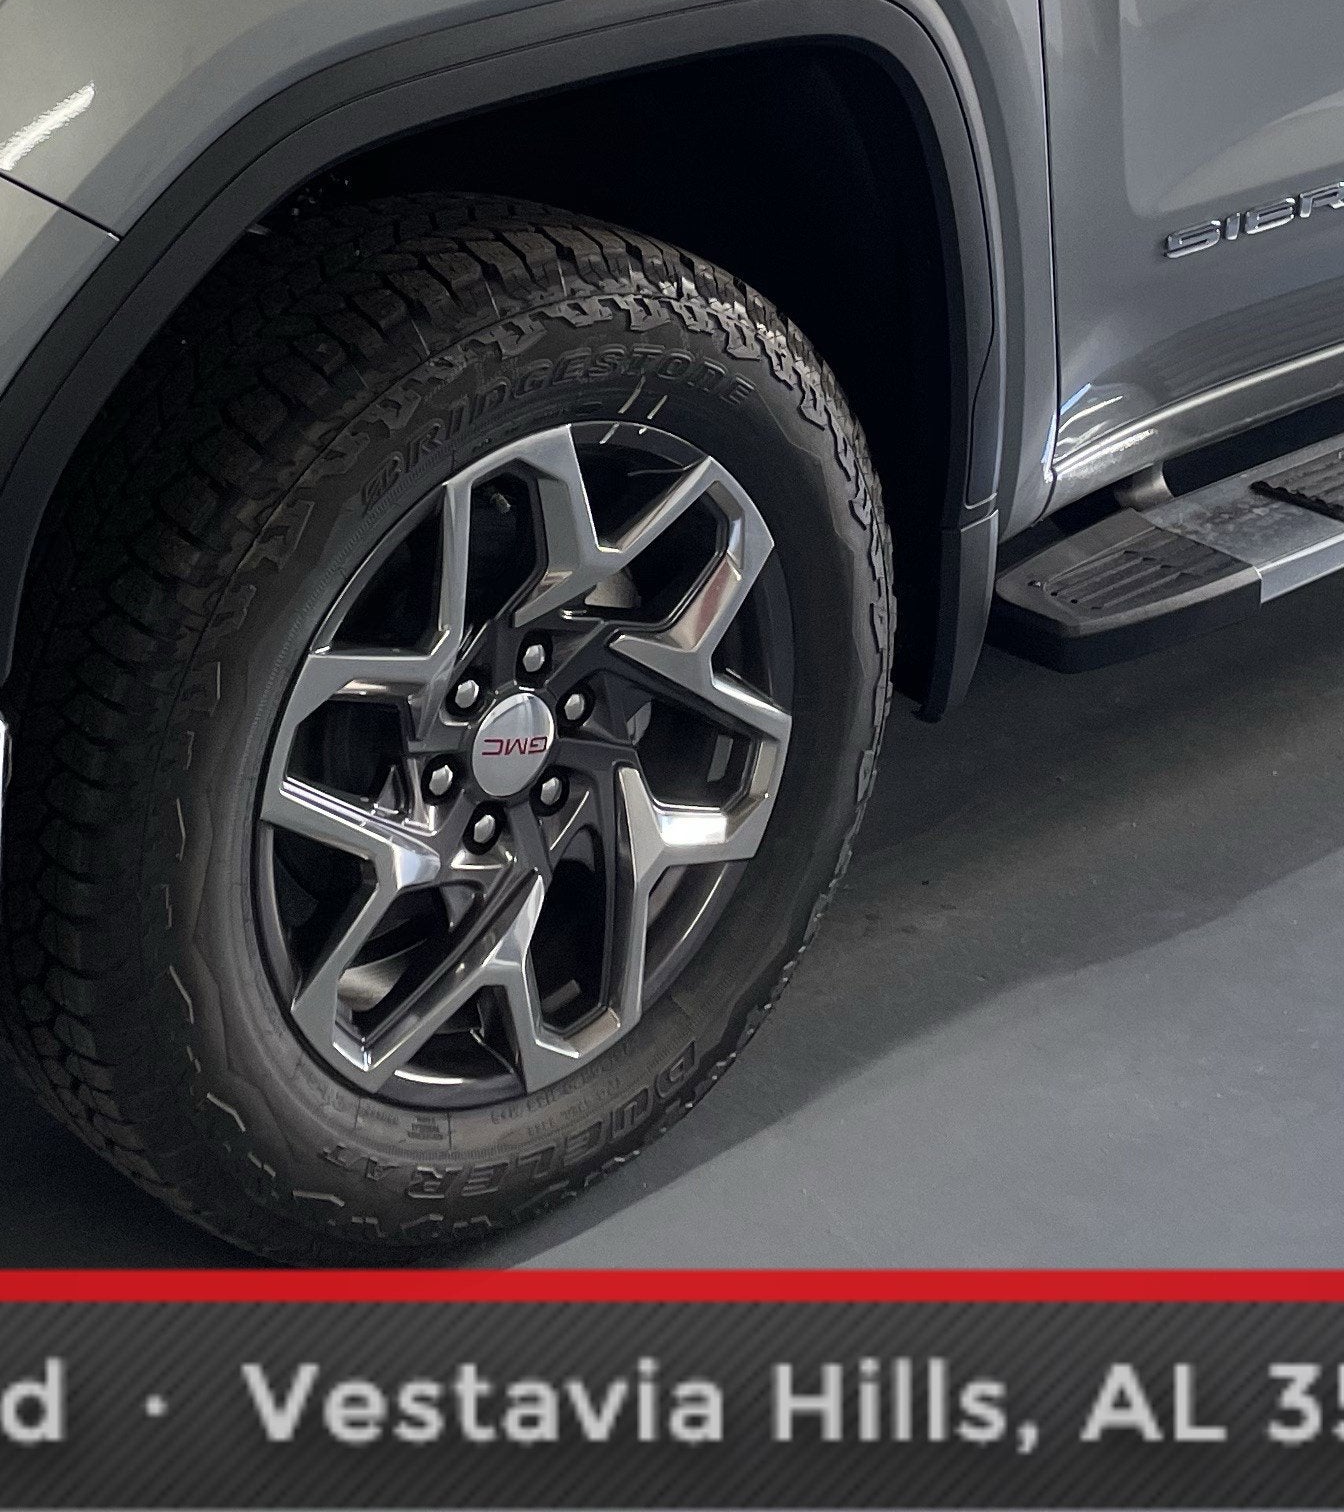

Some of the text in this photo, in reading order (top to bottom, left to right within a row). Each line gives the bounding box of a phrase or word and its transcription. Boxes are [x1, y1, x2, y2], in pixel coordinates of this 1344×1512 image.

[361, 343, 758, 506] BRIDGESTONE
[482, 735, 548, 756] GMC
[407, 1041, 696, 1199] DUELER
